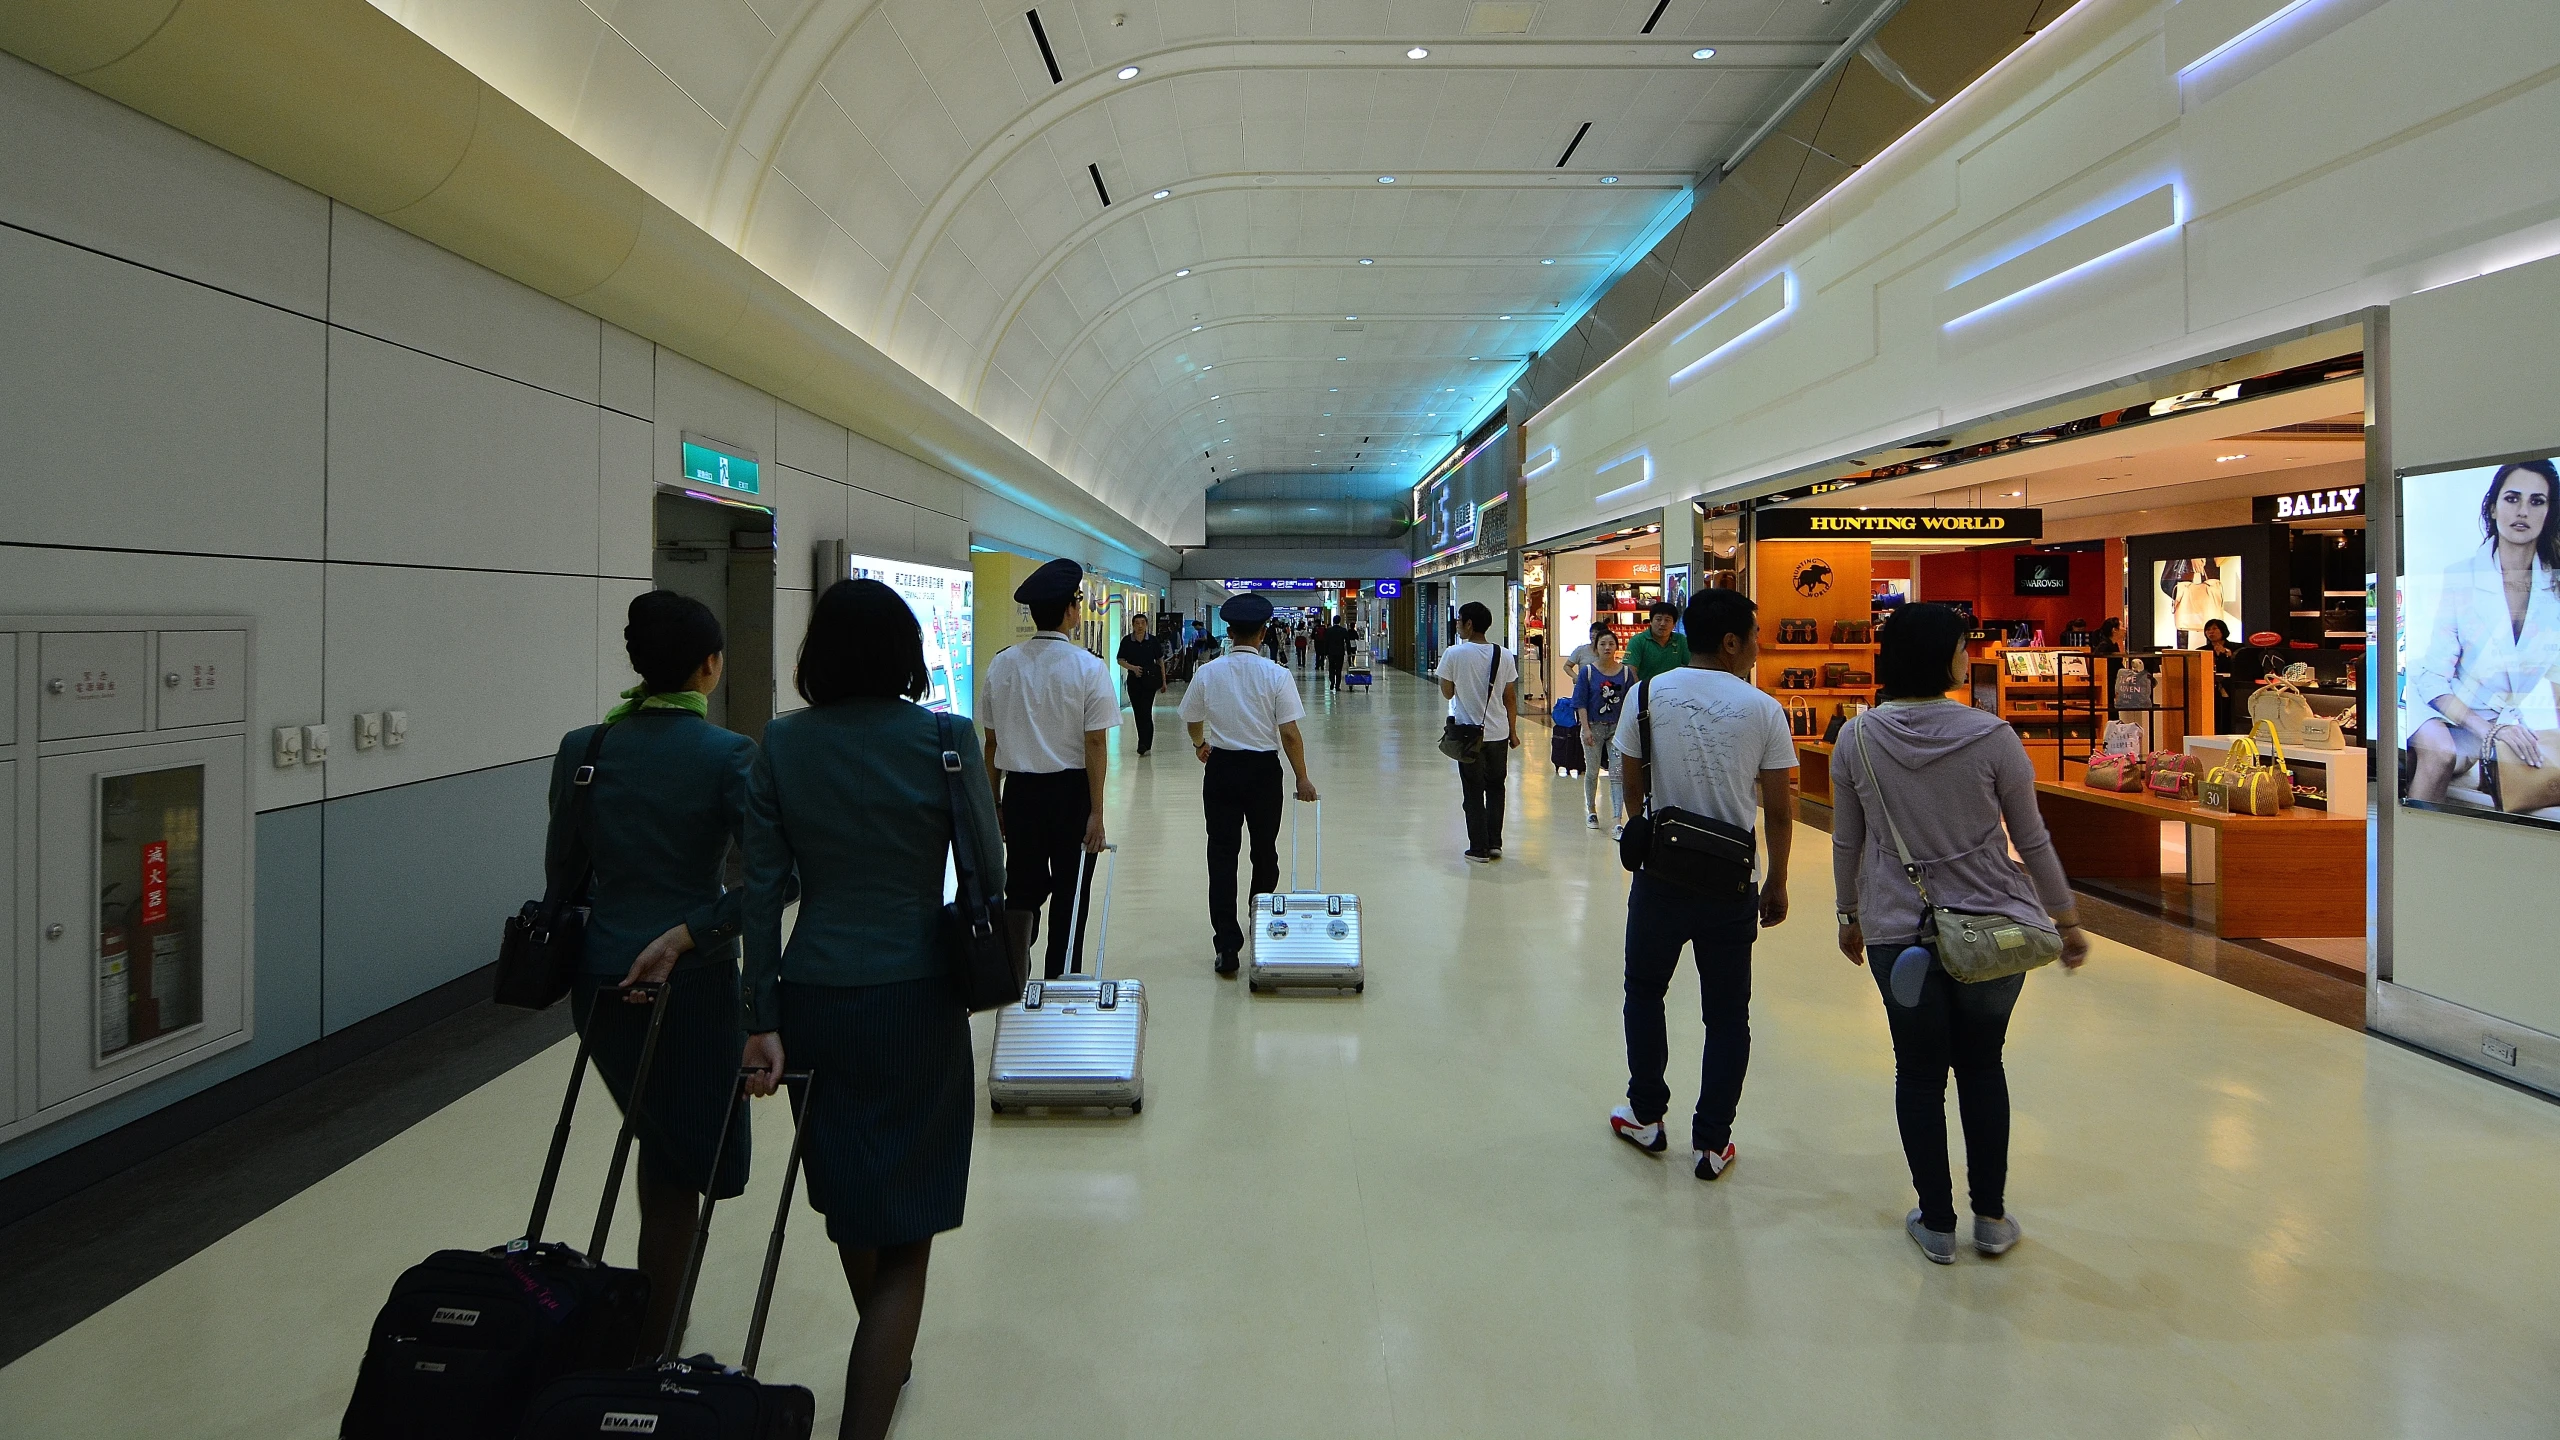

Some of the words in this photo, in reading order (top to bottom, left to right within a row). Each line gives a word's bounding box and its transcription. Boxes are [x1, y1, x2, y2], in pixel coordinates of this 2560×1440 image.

[2277, 488, 2360, 518] BALLY
[1810, 516, 1917, 531] HUNTING
[1920, 516, 2005, 531] WORLD
[1633, 564, 1648, 576] Folli
[1793, 558, 1817, 580] HUNTING
[1807, 585, 1830, 598] WORLD
[2020, 579, 2064, 588] SWAROVSKI
[1379, 583, 1396, 595] C5
[2207, 791, 2220, 806] 30
[147, 846, 165, 908] 滅火器
